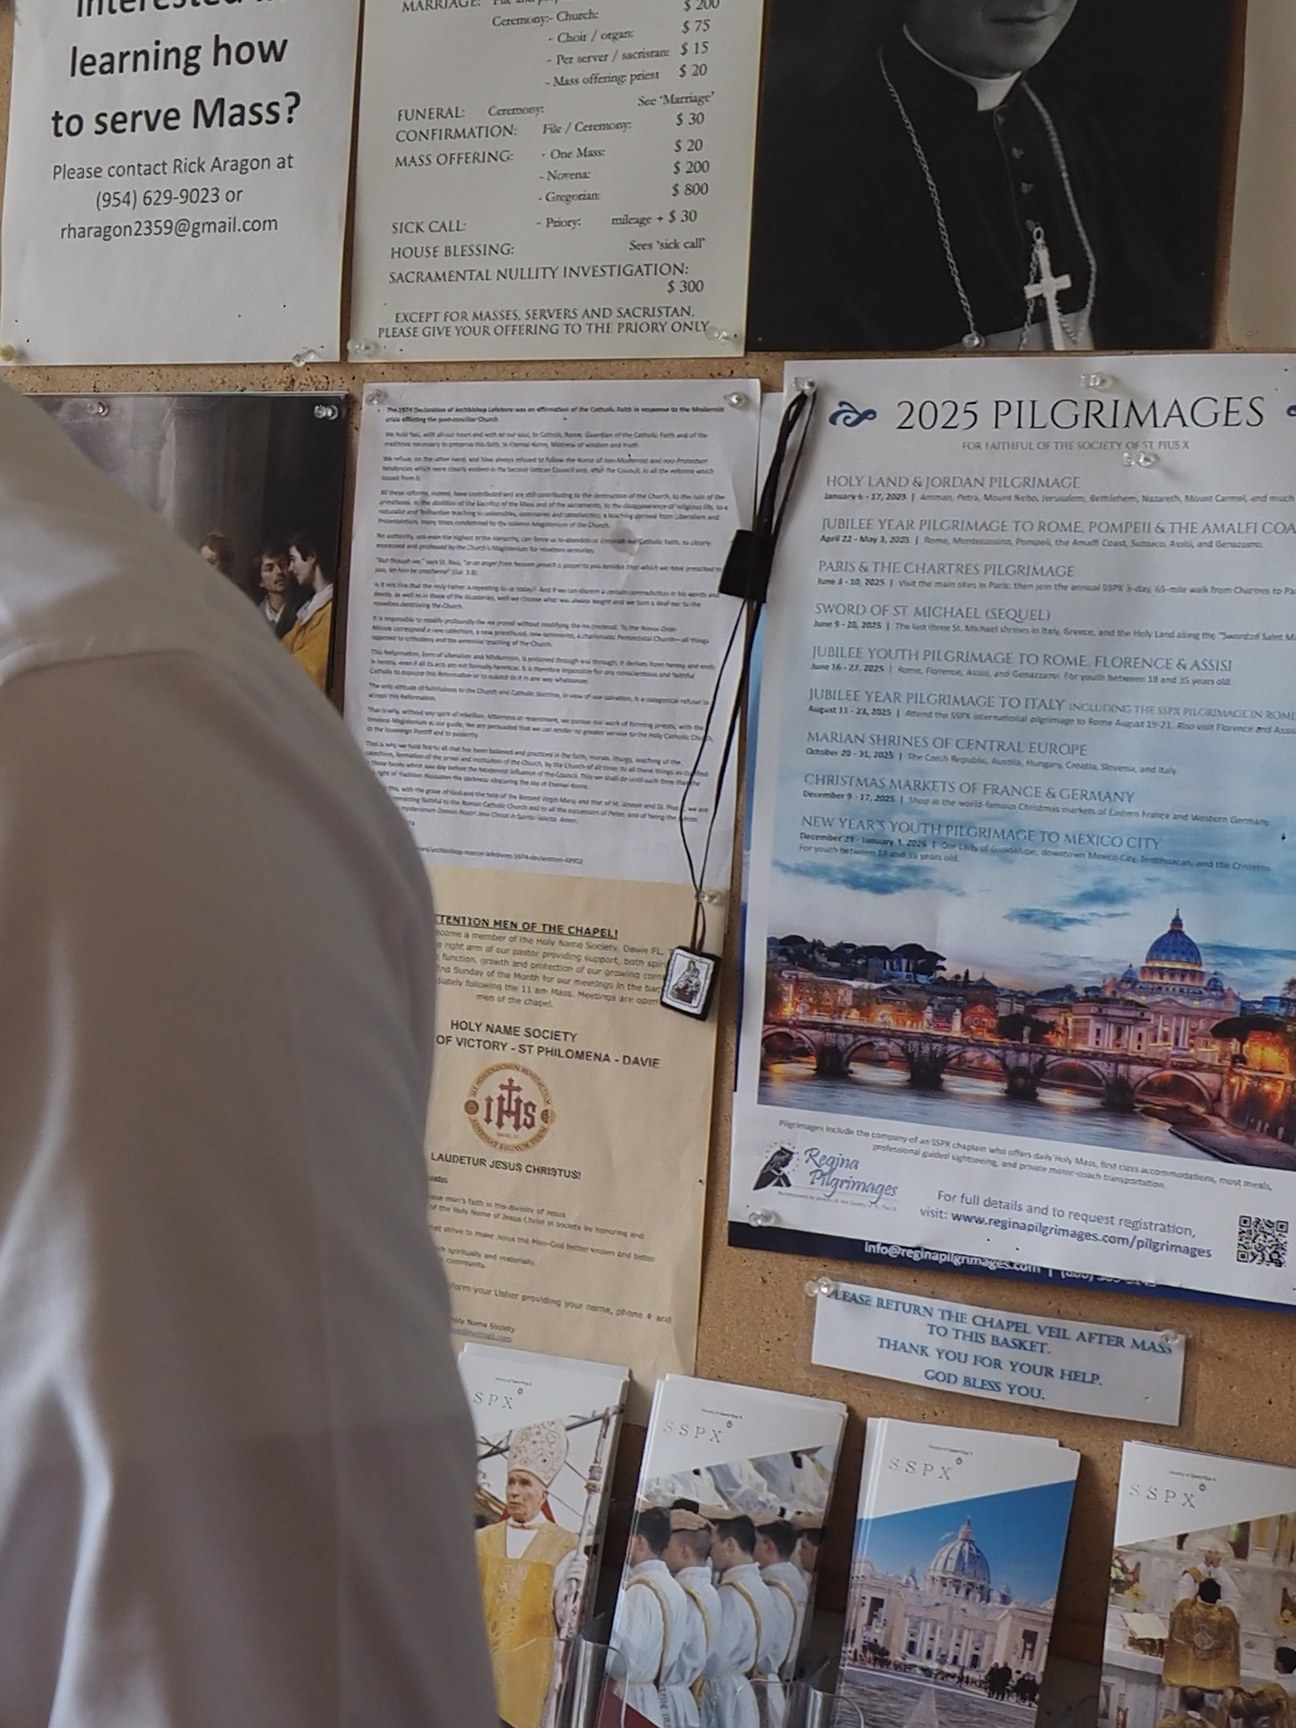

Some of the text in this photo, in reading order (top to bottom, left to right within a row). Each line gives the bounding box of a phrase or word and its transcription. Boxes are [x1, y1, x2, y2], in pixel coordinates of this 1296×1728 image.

[71, 34, 288, 78] learning how
[52, 90, 300, 138] to serve Mass?
[398, 106, 464, 122] FUNERAL:
[396, 124, 516, 142] CONFIRMATION:
[53, 154, 293, 180] Please contact Rick Aragon at
[395, 149, 513, 168] MASS OFFERING:
[97, 186, 243, 211] (954) 629-9023 or
[392, 219, 466, 235] SICK CALL:
[391, 243, 514, 259] HOUSE BLESSING:
[389, 262, 688, 283] SACRAMENTAL NULLITY INVESTIGATION:
[897, 396, 1264, 430] 2025 PILGRIMAGES
[827, 475, 864, 487] HOLY
[868, 475, 909, 487] LAND
[926, 476, 985, 489] JORDAN
[990, 476, 1080, 489] PILGRIMAGE
[816, 603, 866, 615] SWORD
[870, 604, 888, 617] OF
[914, 605, 980, 619] MICHAEL
[985, 607, 1050, 623] (SEQUEL)
[451, 1020, 577, 1042] HOLY NAME SOCIETY
[435, 1034, 659, 1068] OF VICTORY ST PHILOMENA DAVIE
[804, 1147, 859, 1176] Regina
[809, 1167, 898, 1202] Pilgrimages
[920, 1208, 947, 1220] visit:
[938, 1190, 1195, 1239] For full details and to request registration,
[827, 1289, 872, 1307] LEASE
[876, 1297, 933, 1318] RETURN
[938, 1308, 966, 1324] THE
[972, 1314, 1030, 1334] CHAPEL
[1038, 1325, 1070, 1340] VEIL
[1076, 1331, 1125, 1348] AFTER
[927, 1323, 1048, 1353] TO THIS BASKET.
[878, 1337, 1102, 1386] THANK YOU FOR YOUR HELP.
[925, 1369, 1044, 1400] GOD BLESS YOU.
[888, 1457, 953, 1481] SSPX
[1128, 1483, 1197, 1509] SSPX
